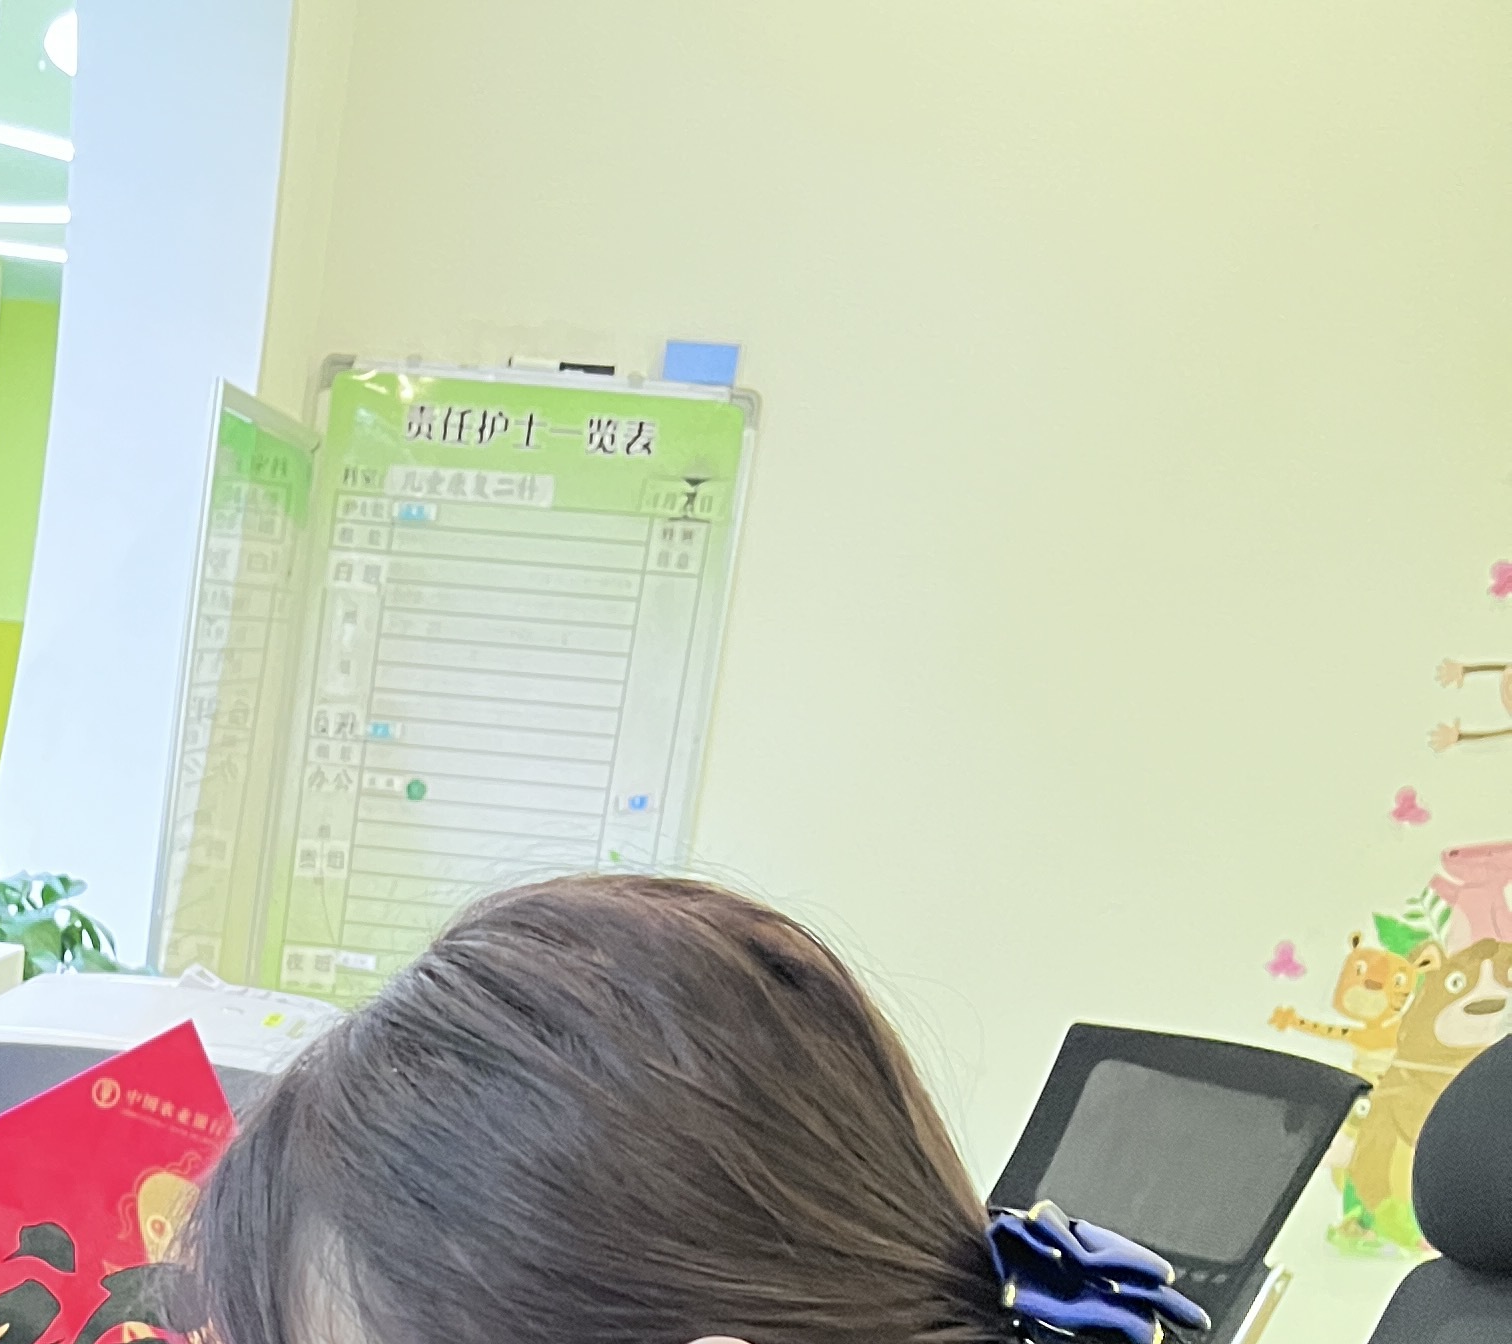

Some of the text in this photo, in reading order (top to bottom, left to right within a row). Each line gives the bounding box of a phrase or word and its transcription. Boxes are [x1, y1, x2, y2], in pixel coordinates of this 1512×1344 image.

[405, 404, 656, 455] 责任护士一览表
